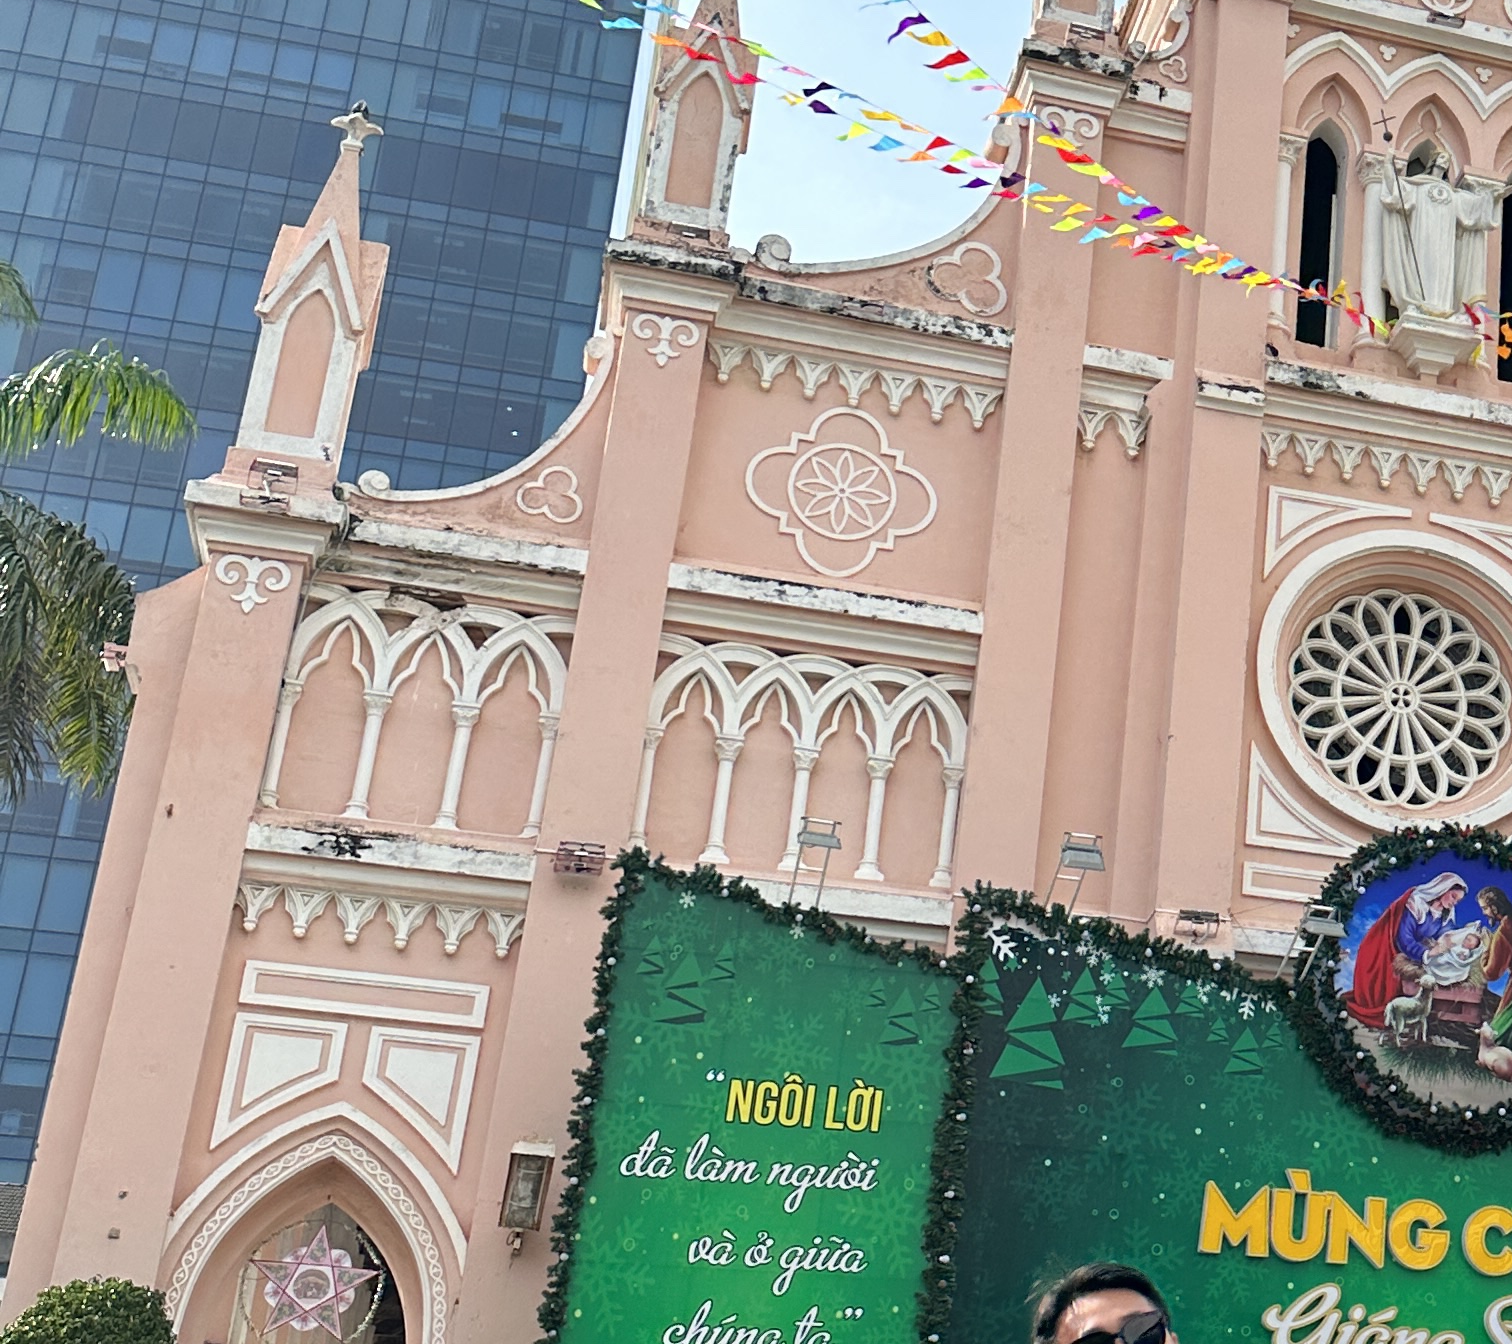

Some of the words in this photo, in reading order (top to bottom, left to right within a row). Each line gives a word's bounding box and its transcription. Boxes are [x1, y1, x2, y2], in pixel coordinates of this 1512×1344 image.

[823, 1078, 885, 1133] LỜI
[619, 1129, 677, 1178] đã
[685, 1132, 760, 1184] làm
[766, 1150, 881, 1213] người
[688, 1229, 737, 1266] và
[743, 1231, 775, 1268] ở
[772, 1235, 869, 1296] giữa
